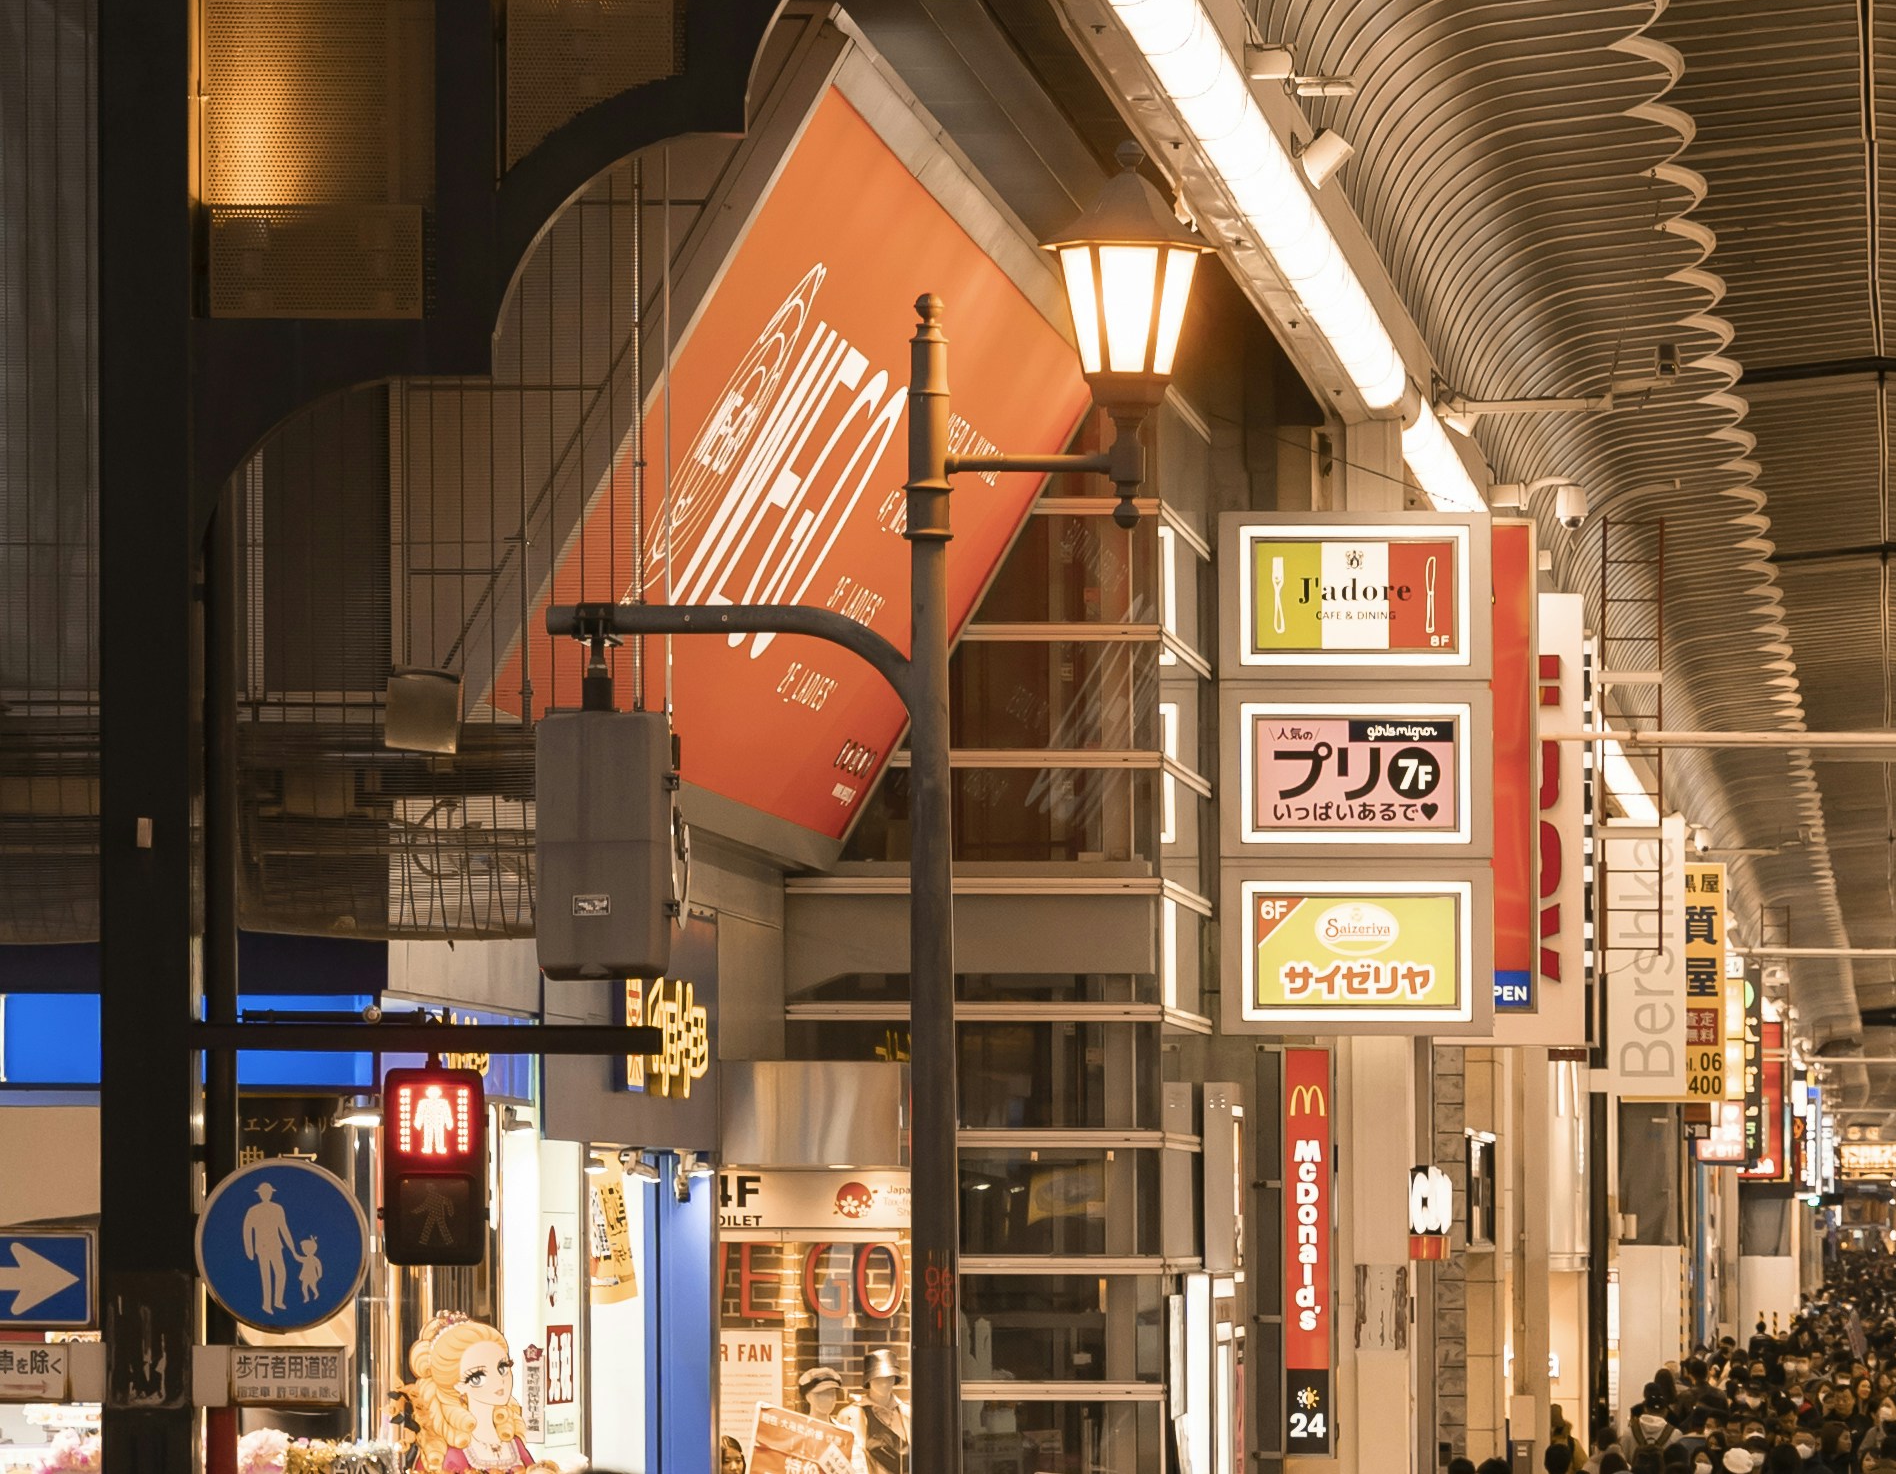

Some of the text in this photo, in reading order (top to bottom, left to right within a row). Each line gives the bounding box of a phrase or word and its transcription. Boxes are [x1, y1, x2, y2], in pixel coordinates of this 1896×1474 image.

[668, 321, 909, 659] WEGO
[1298, 577, 1412, 604] J'adore
[1316, 611, 1396, 620] CAFE & DINING
[1430, 635, 1449, 647] 8F
[1277, 727, 1313, 741] 人気の
[1274, 741, 1381, 801] プリ
[1398, 758, 1433, 790] 7F
[1273, 801, 1419, 821] いっぱいあるで
[1261, 901, 1287, 920] 6F
[1326, 918, 1390, 938] Saizeriya
[1619, 838, 1675, 1078] Bershka
[1686, 906, 1718, 997] 質屋
[1283, 963, 1432, 996] サイゼリヤ
[1494, 985, 1528, 1001] PEN
[1700, 1053, 1722, 1072] 06
[1689, 1076, 1722, 1095] 400
[886, 1185, 911, 1195] Japa
[1293, 1139, 1322, 1331] McDonald's
[737, 1344, 772, 1362] FAN
[236, 1355, 338, 1379] 歩行者用道路
[1289, 1413, 1327, 1439] 24
